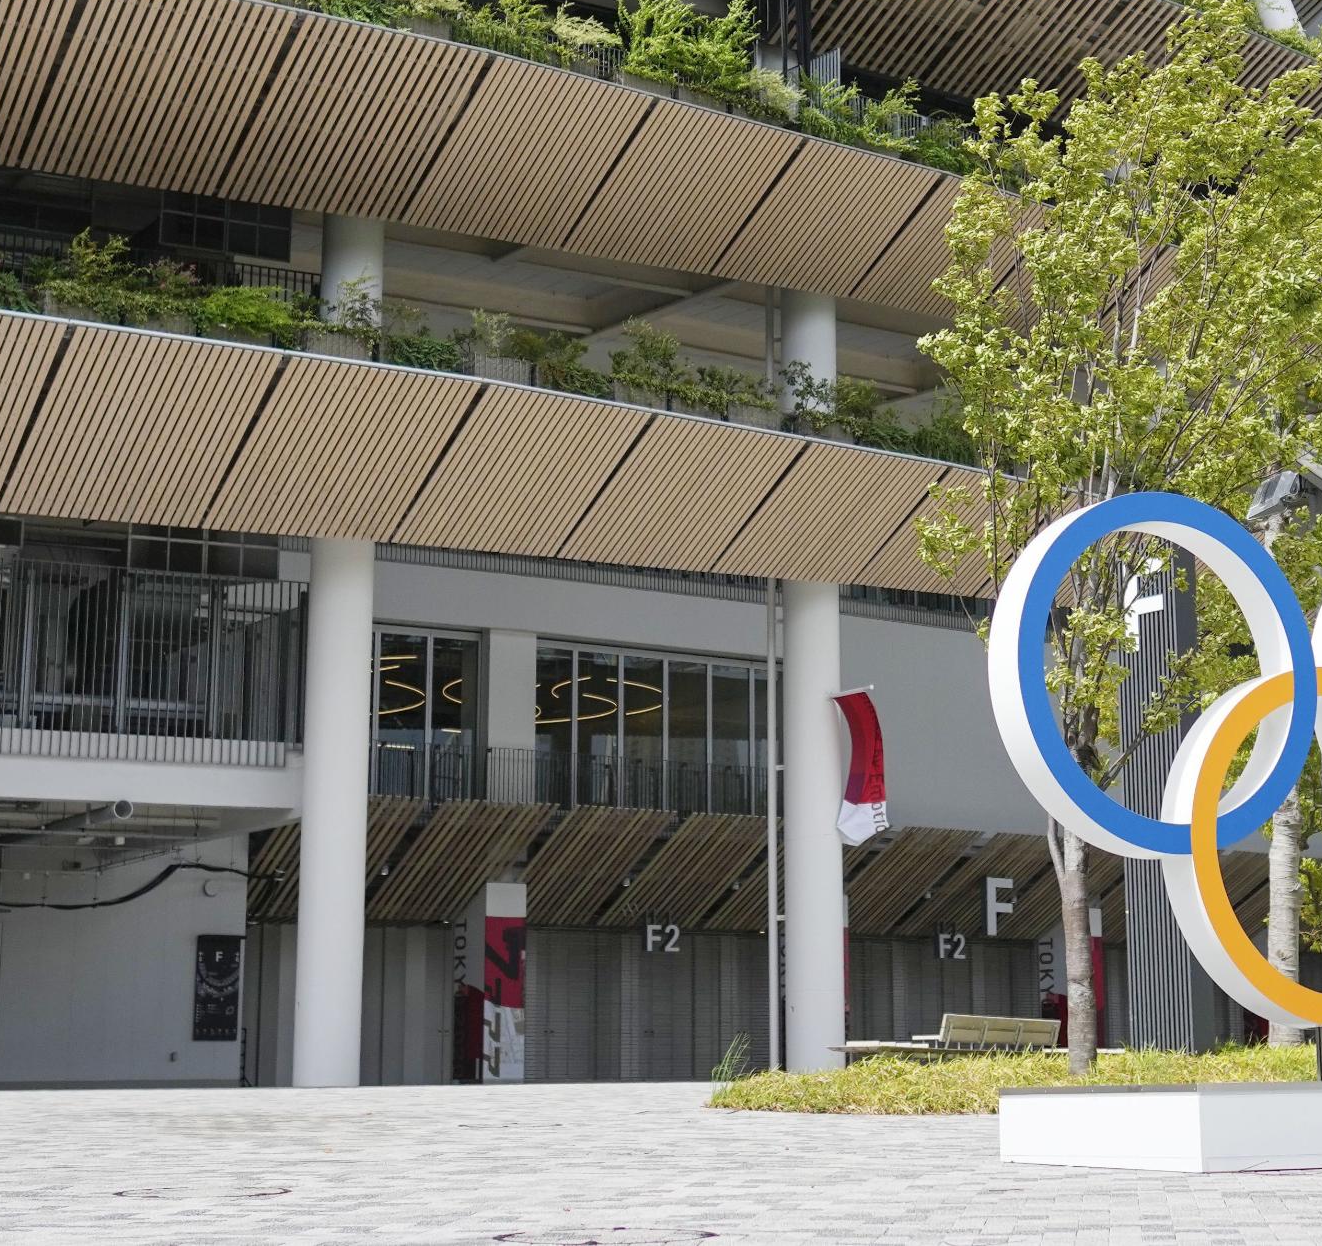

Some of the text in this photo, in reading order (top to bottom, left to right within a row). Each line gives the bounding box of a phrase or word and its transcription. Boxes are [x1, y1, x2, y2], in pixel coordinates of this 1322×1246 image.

[986, 877, 1013, 936] F
[647, 925, 680, 952] F2
[939, 934, 966, 959] F2
[215, 951, 223, 963] F
